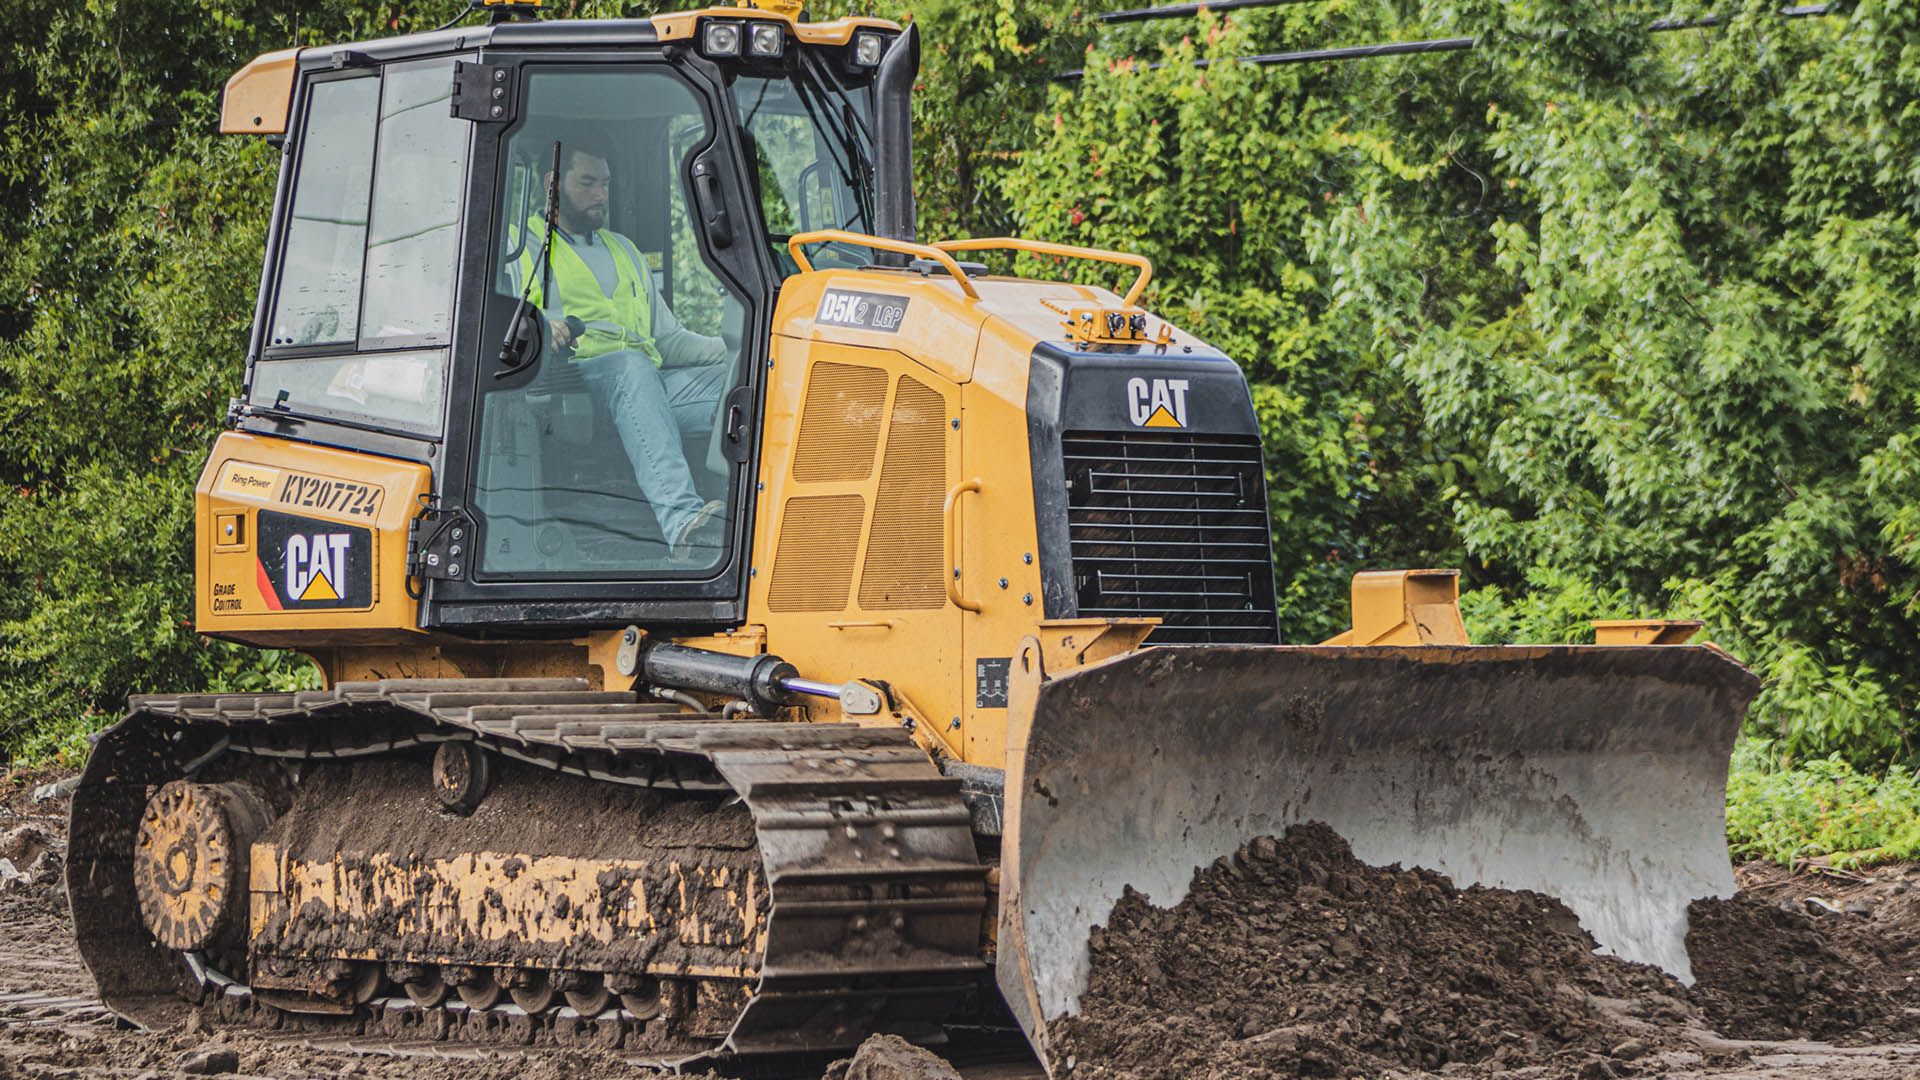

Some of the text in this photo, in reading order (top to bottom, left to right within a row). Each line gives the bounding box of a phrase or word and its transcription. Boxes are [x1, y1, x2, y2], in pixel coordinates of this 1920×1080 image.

[1127, 377, 1189, 428] CAT
[231, 473, 272, 488] Ring Power
[280, 474, 381, 516] KY207724
[286, 534, 350, 601] CAT
[213, 583, 236, 596] GRADE
